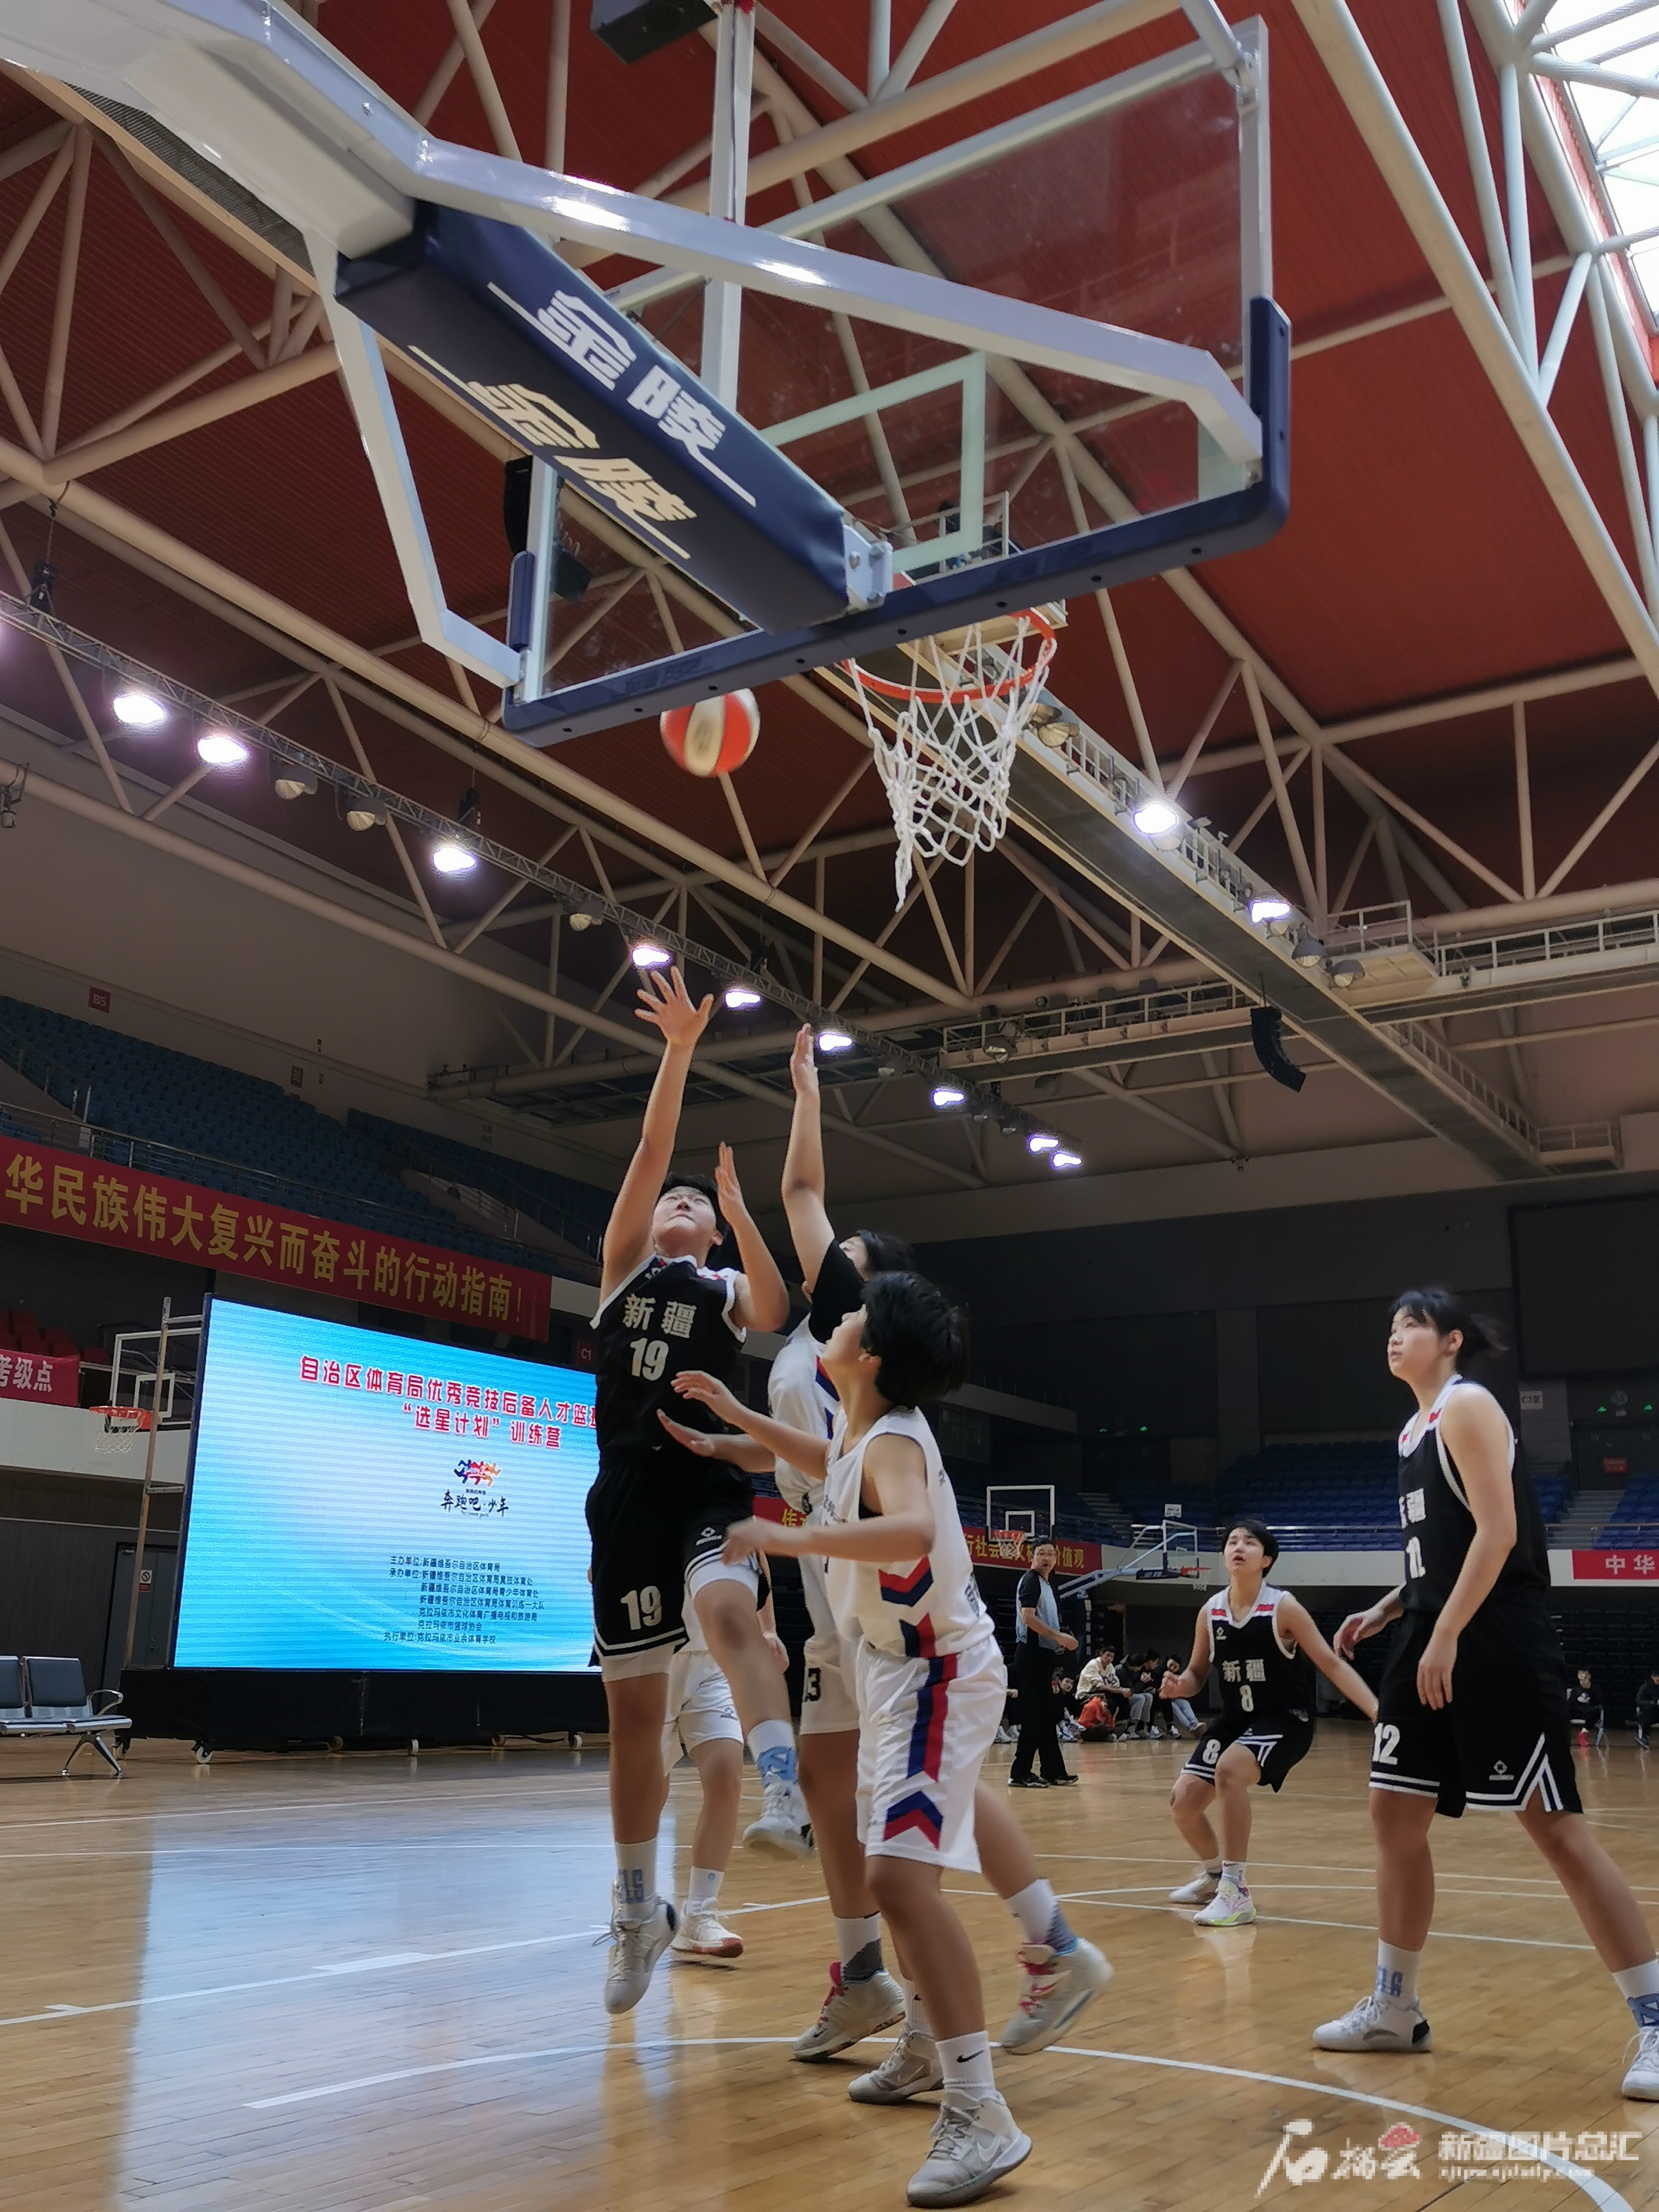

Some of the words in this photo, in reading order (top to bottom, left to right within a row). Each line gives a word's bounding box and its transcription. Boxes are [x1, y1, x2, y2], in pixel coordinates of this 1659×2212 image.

[623, 1293, 697, 1338] 新疆
[581, 1347, 592, 1361] C1
[630, 1338, 669, 1381] 19
[1606, 1555, 1655, 1575] 中华
[620, 1586, 662, 1631] 19
[1222, 1659, 1266, 1683] 新疆
[1240, 1684, 1254, 1712] 8
[1373, 1722, 1400, 1765] 12
